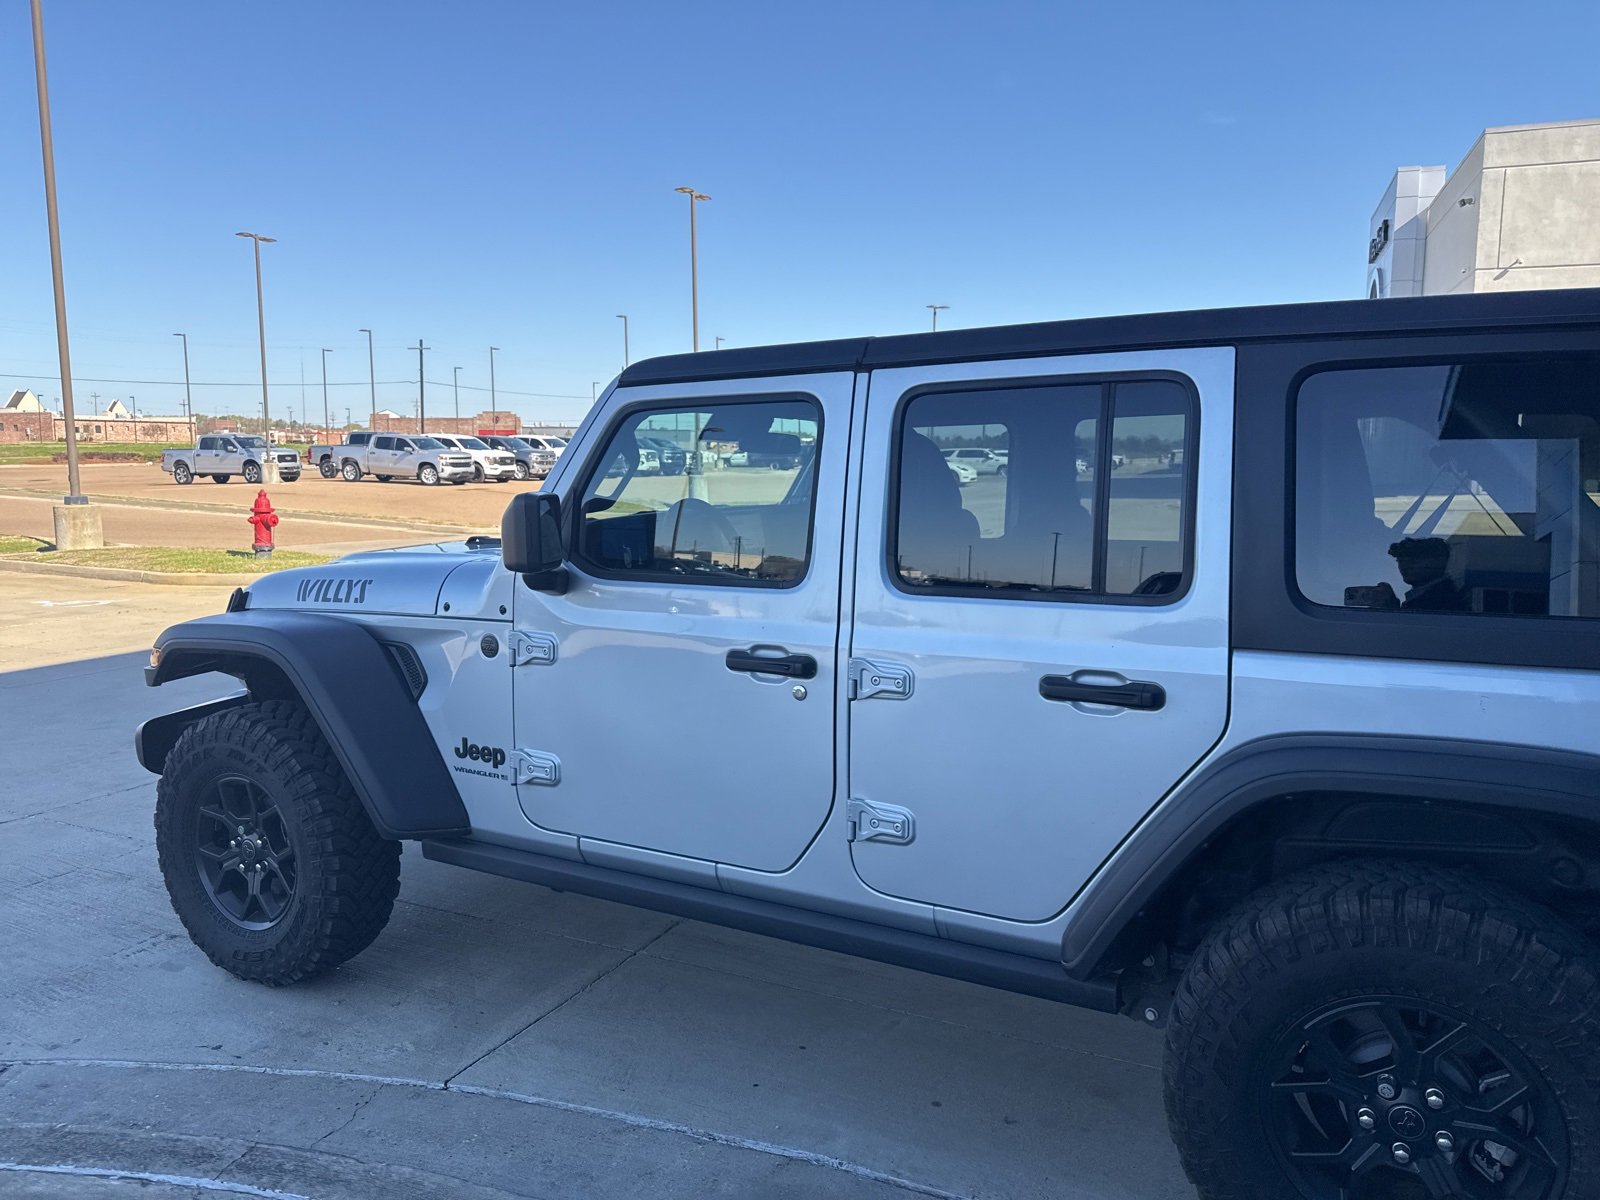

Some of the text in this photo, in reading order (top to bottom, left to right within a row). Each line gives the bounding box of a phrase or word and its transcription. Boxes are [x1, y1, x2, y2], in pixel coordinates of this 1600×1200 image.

[297, 579, 374, 604] WILLYS
[454, 736, 506, 769] Jeep
[453, 765, 500, 780] WRANGLER
